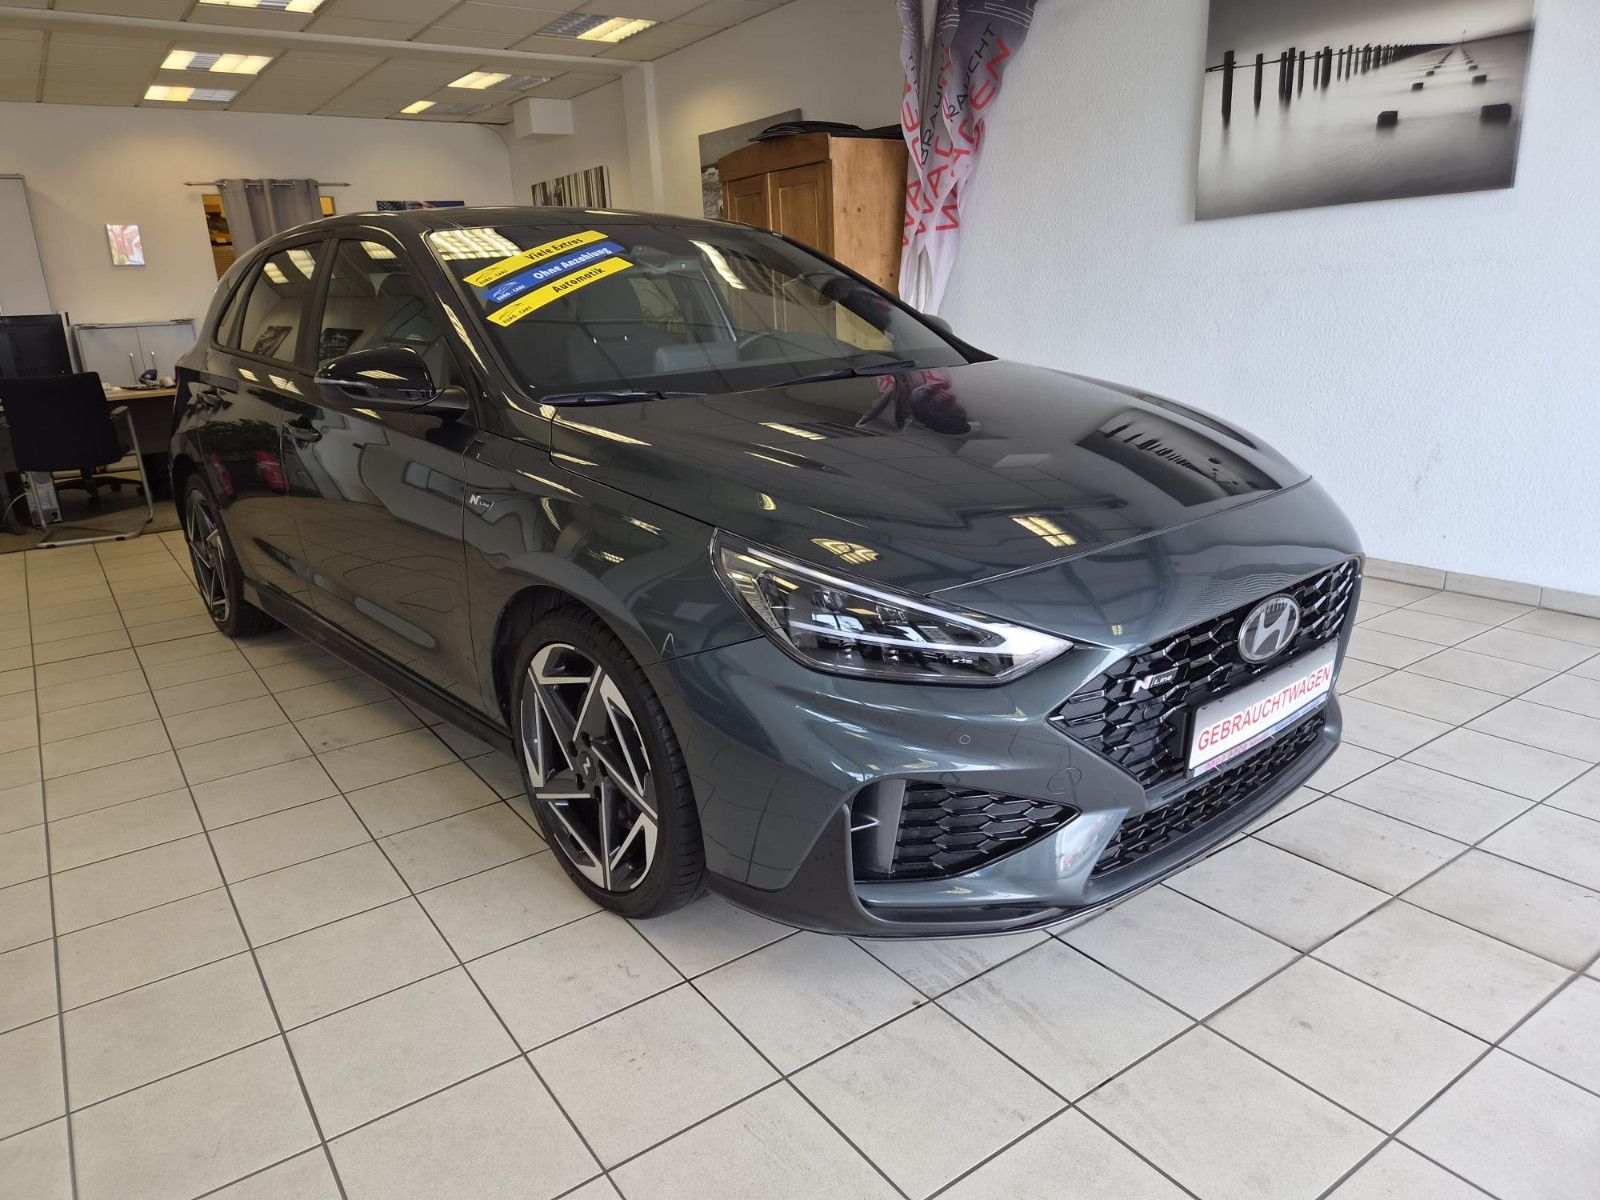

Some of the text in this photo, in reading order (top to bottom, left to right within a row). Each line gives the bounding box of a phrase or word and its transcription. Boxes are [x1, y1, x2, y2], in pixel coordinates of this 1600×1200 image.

[525, 237, 584, 261] Viele Extras
[533, 246, 613, 280] Ohne Anzahlung
[552, 267, 606, 294] Automatik
[1197, 666, 1332, 751] GEBRAUCHTWAGEN
